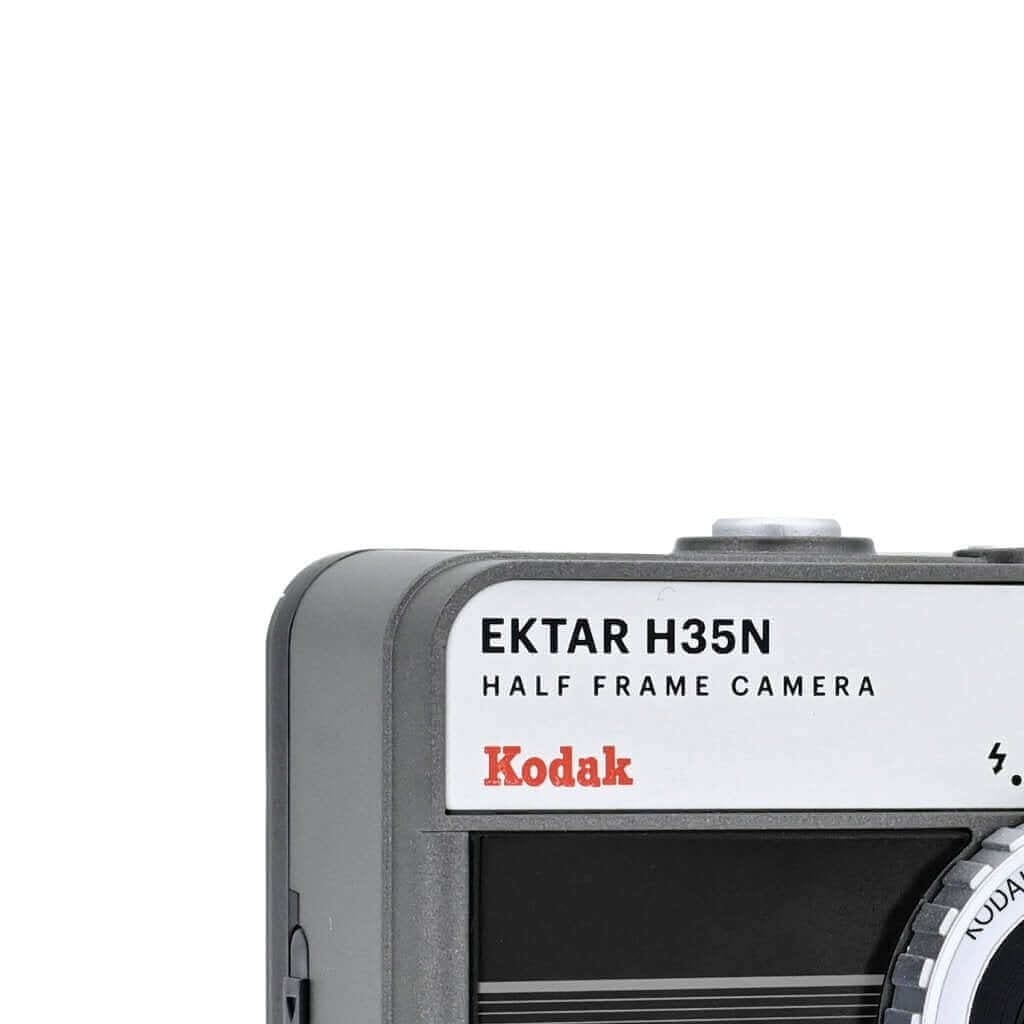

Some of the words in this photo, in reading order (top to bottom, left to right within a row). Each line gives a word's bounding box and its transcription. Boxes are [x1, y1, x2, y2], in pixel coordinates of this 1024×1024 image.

[481, 617, 630, 655] EKTAR
[646, 617, 771, 655] H35N
[482, 675, 572, 697] HALF
[593, 675, 710, 697] FRAME
[731, 675, 876, 697] CAMERA
[484, 745, 634, 788] Kodak
